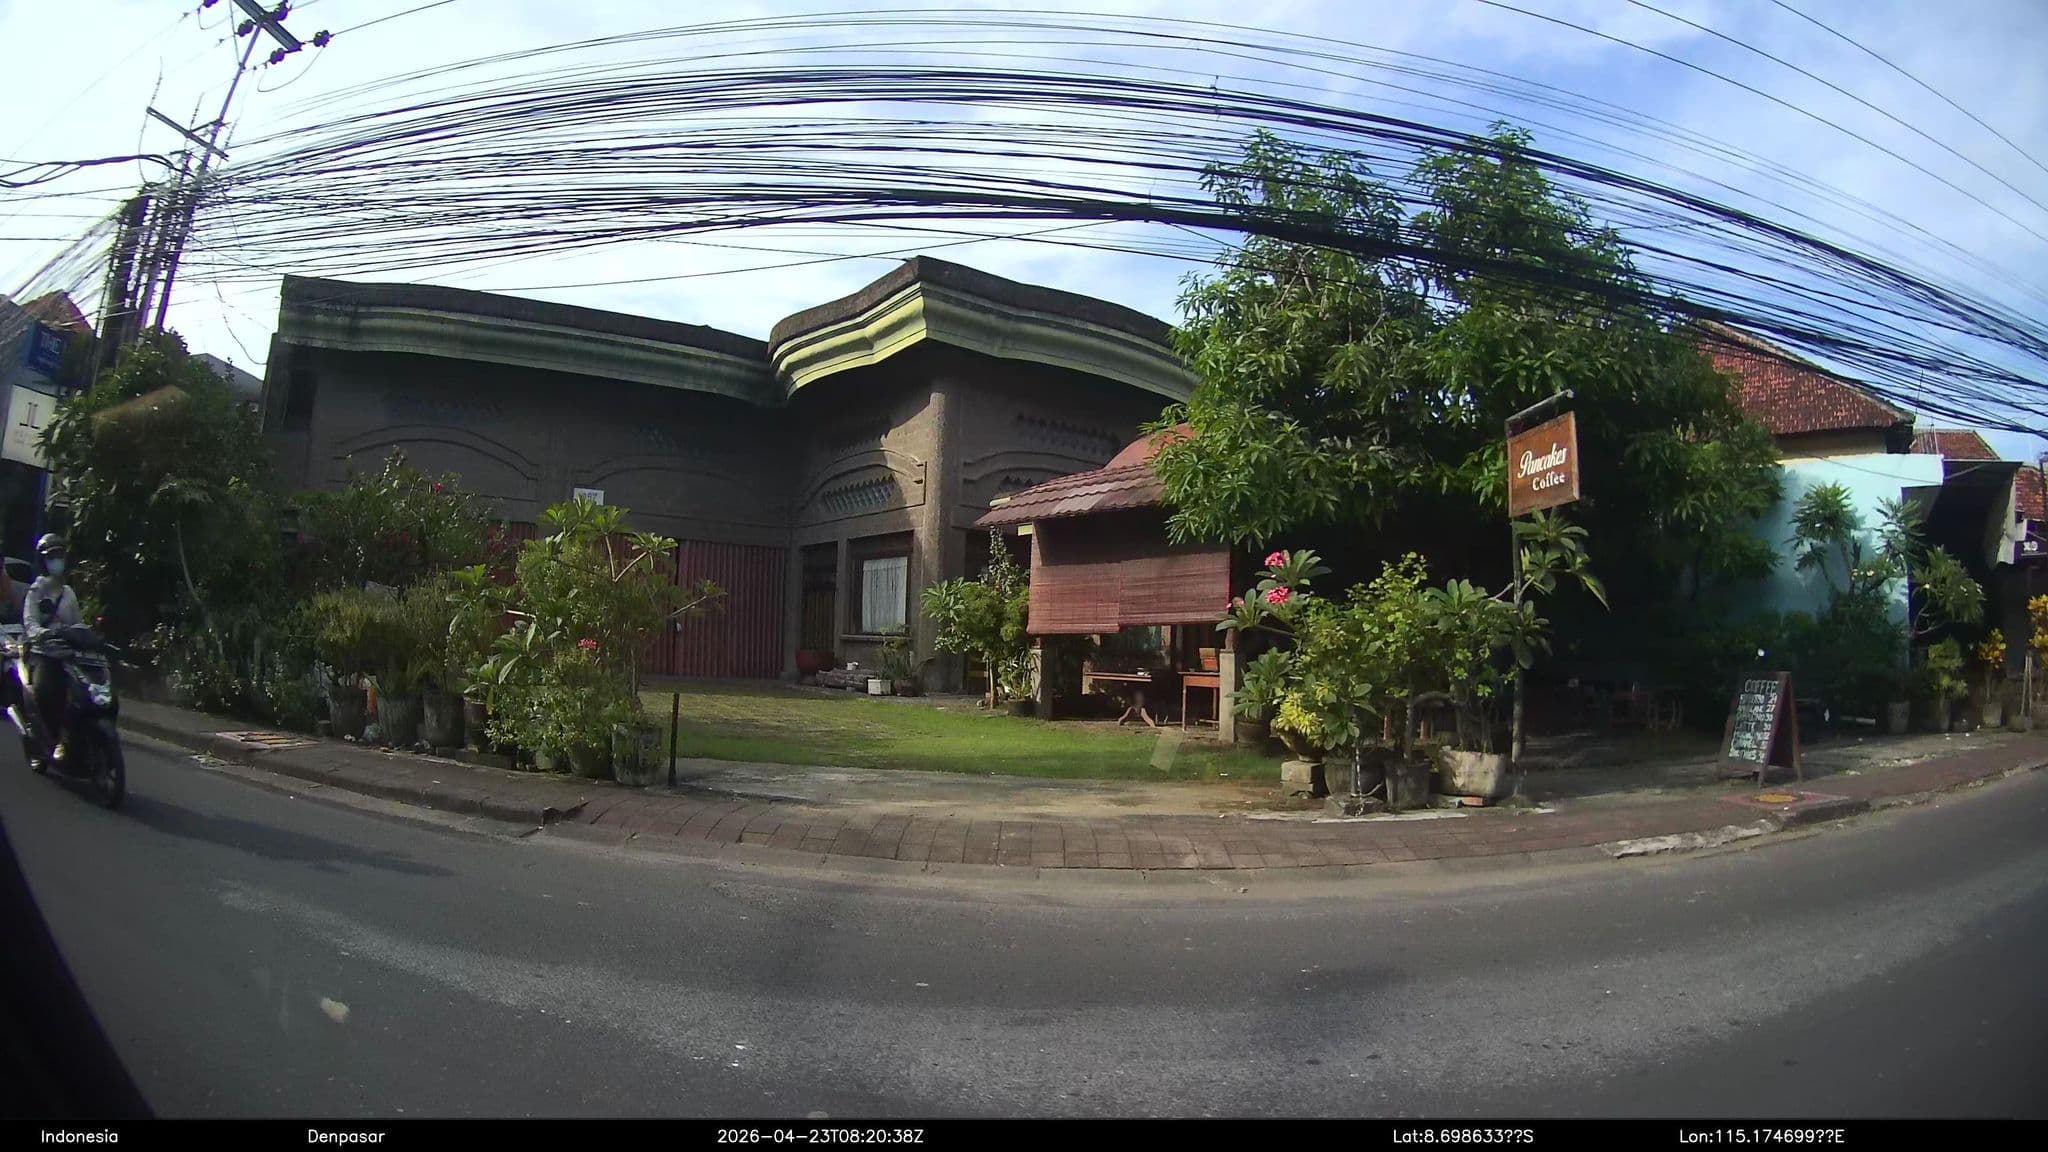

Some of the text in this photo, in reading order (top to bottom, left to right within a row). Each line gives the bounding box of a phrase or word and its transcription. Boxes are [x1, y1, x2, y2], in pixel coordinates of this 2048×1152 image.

[1517, 442, 1567, 479] Pancakes
[1532, 471, 1566, 491] Coffee
[1743, 679, 1779, 694] COFFEE
